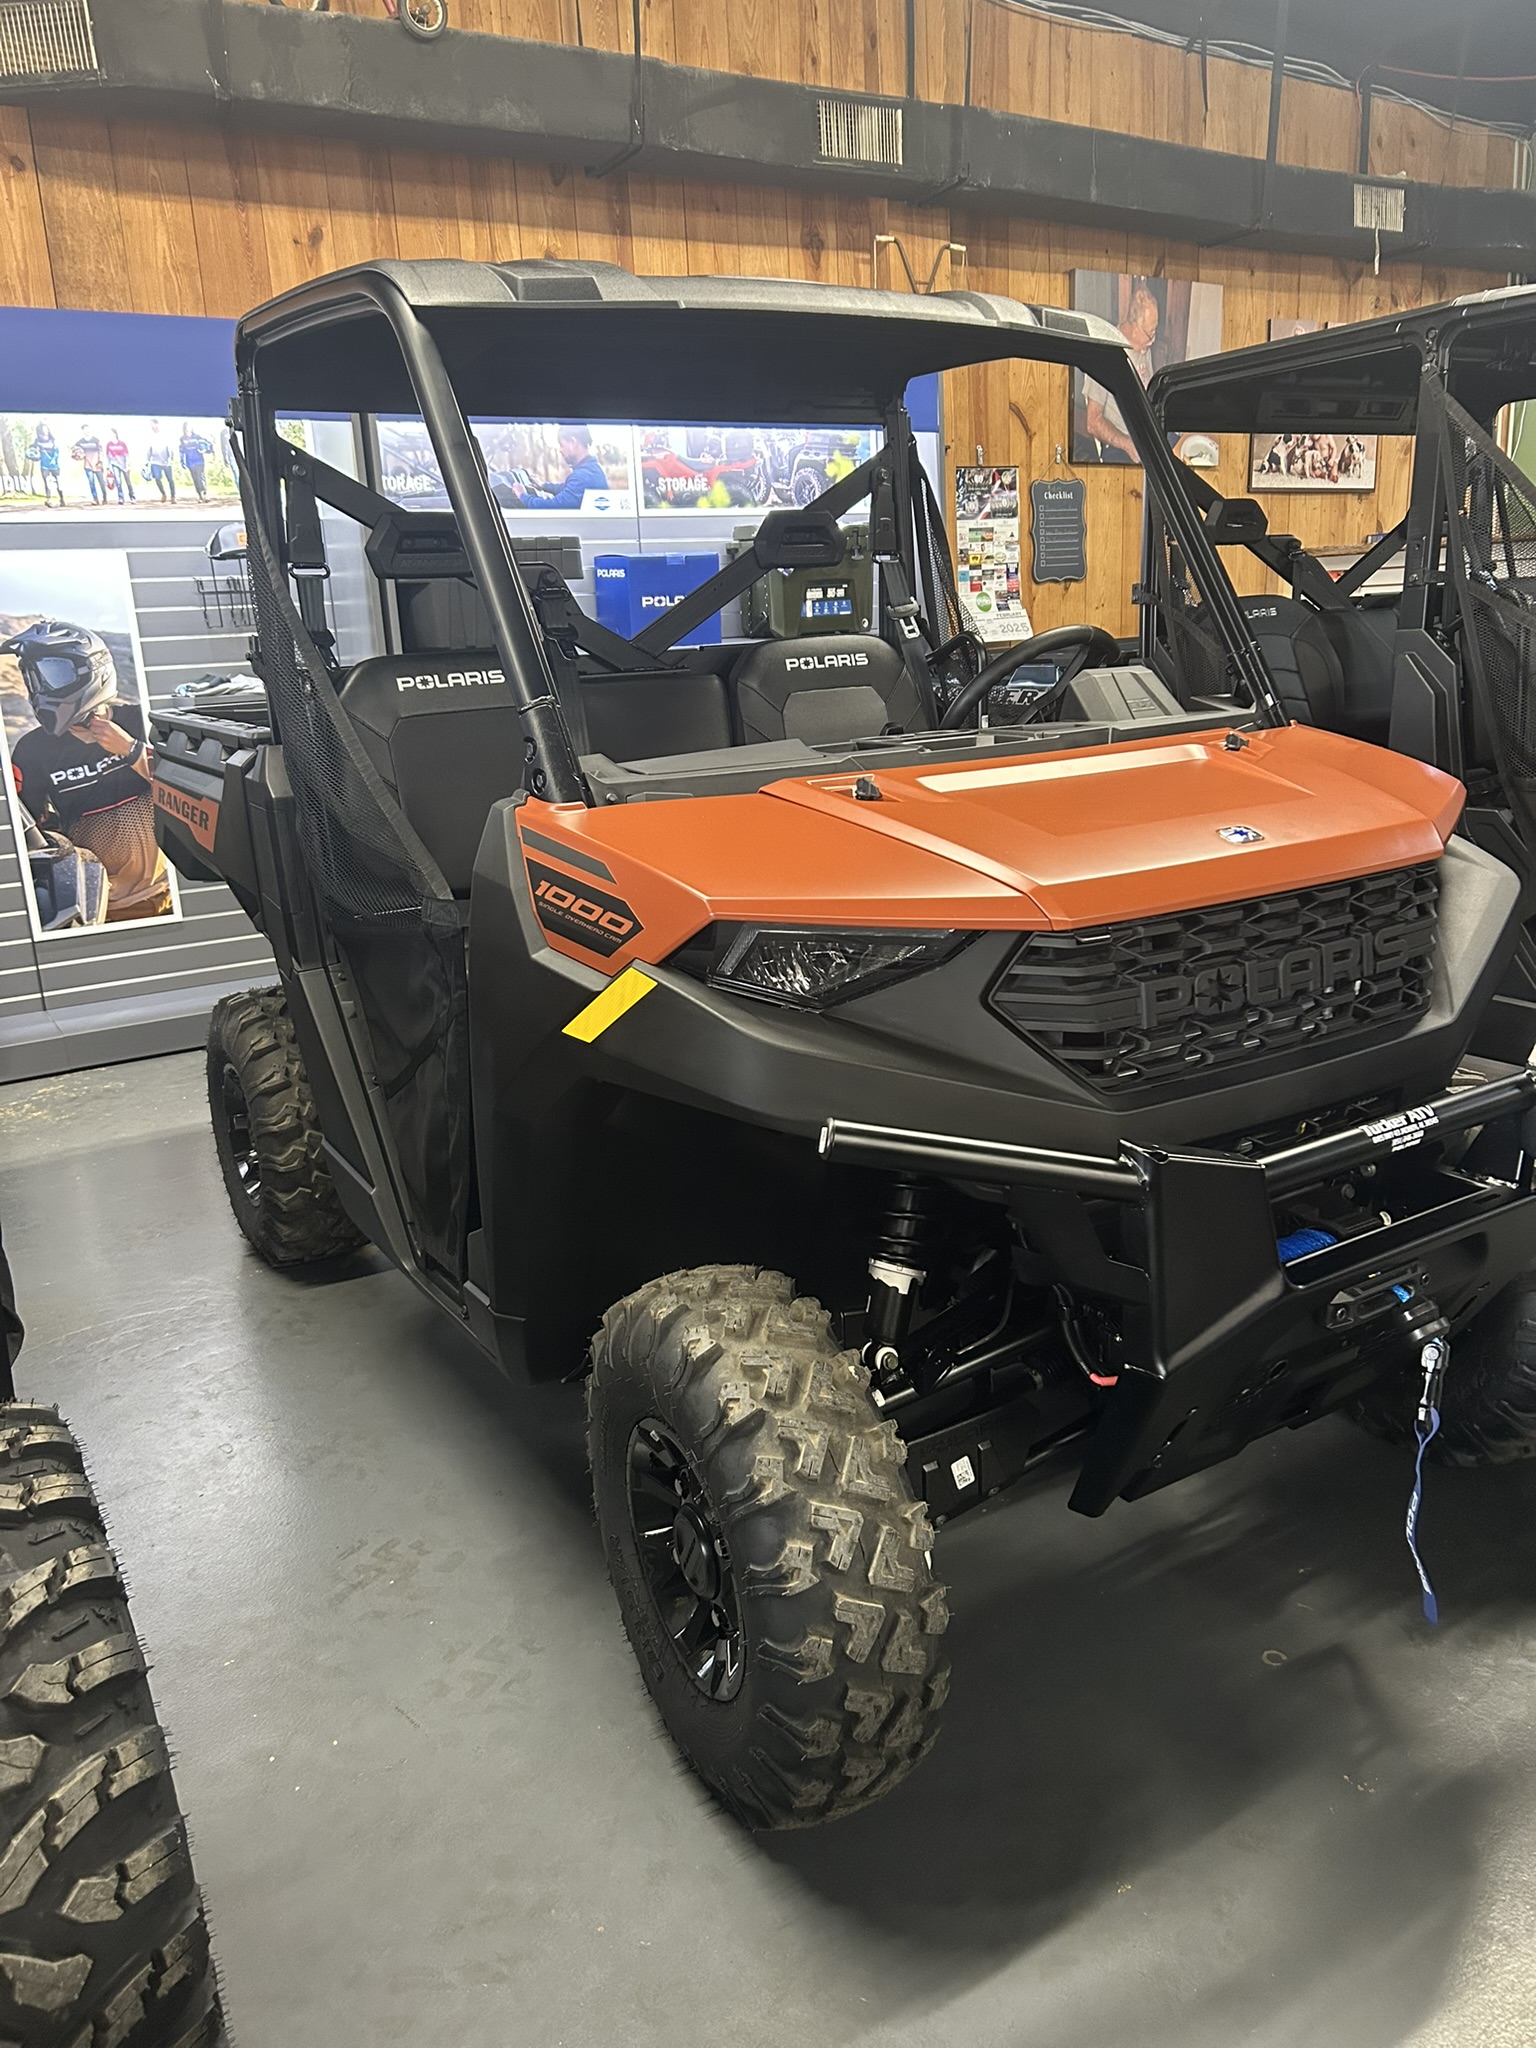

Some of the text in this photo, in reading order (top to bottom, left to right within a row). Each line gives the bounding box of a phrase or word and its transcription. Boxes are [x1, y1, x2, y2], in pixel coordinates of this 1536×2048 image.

[382, 475, 431, 492] TORAGE
[658, 477, 709, 491] STORAGE
[1044, 490, 1073, 500] Checklist
[597, 568, 625, 578] POLARIS
[1244, 607, 1277, 619] LARIS
[1000, 622, 1029, 634] 2025
[785, 653, 869, 671] POLARIS
[396, 669, 506, 692] POLARIS
[158, 787, 209, 830] RANGER
[535, 880, 634, 936] 1000
[538, 901, 622, 944] SINGLE OVERHEAD CAM
[1140, 924, 1409, 1030] POLARIS
[1358, 1115, 1408, 1137] Tucker
[1405, 1104, 1435, 1122] ATV
